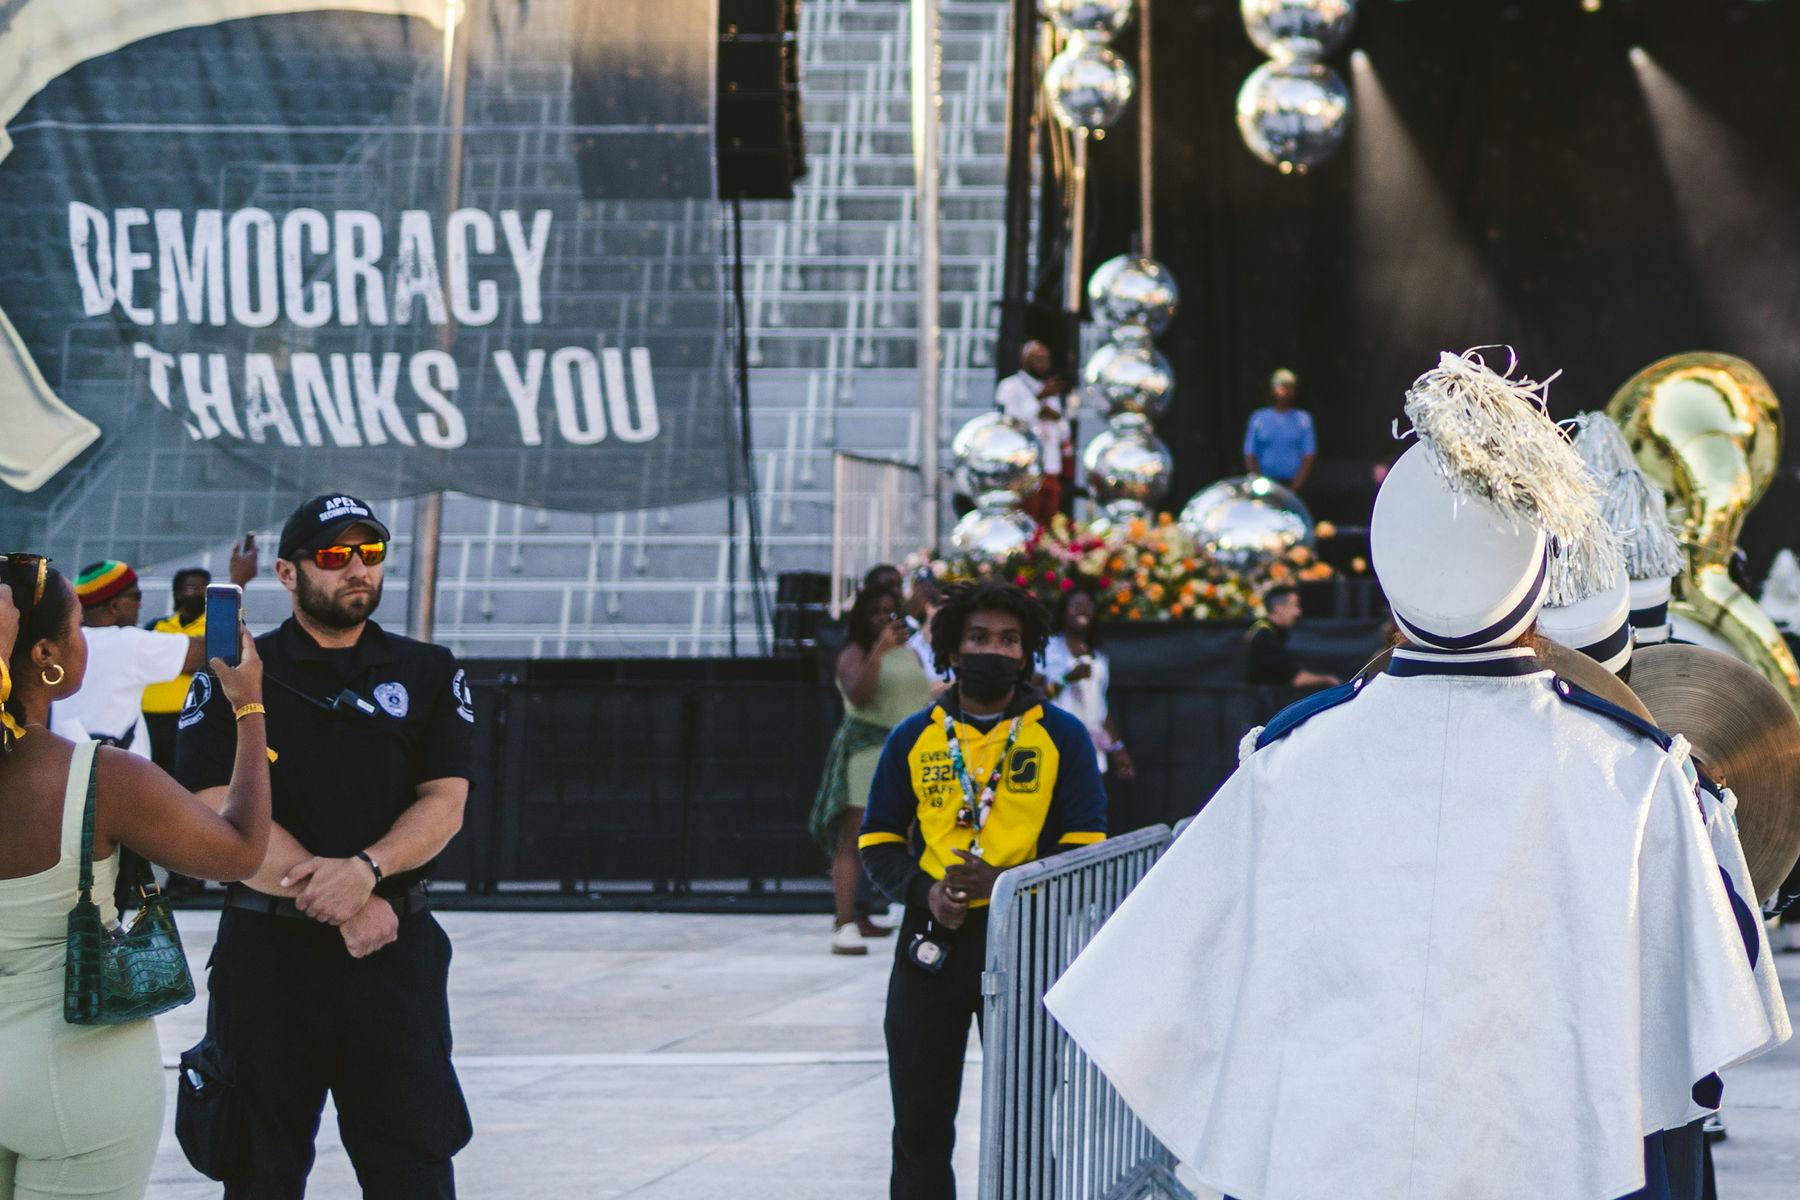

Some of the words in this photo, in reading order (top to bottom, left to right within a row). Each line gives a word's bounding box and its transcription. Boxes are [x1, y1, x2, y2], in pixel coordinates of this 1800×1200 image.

[69, 201, 553, 328] DEMOCRACY
[134, 342, 469, 450] THANKS
[494, 346, 661, 447] YOU
[920, 751, 951, 763] EVEN
